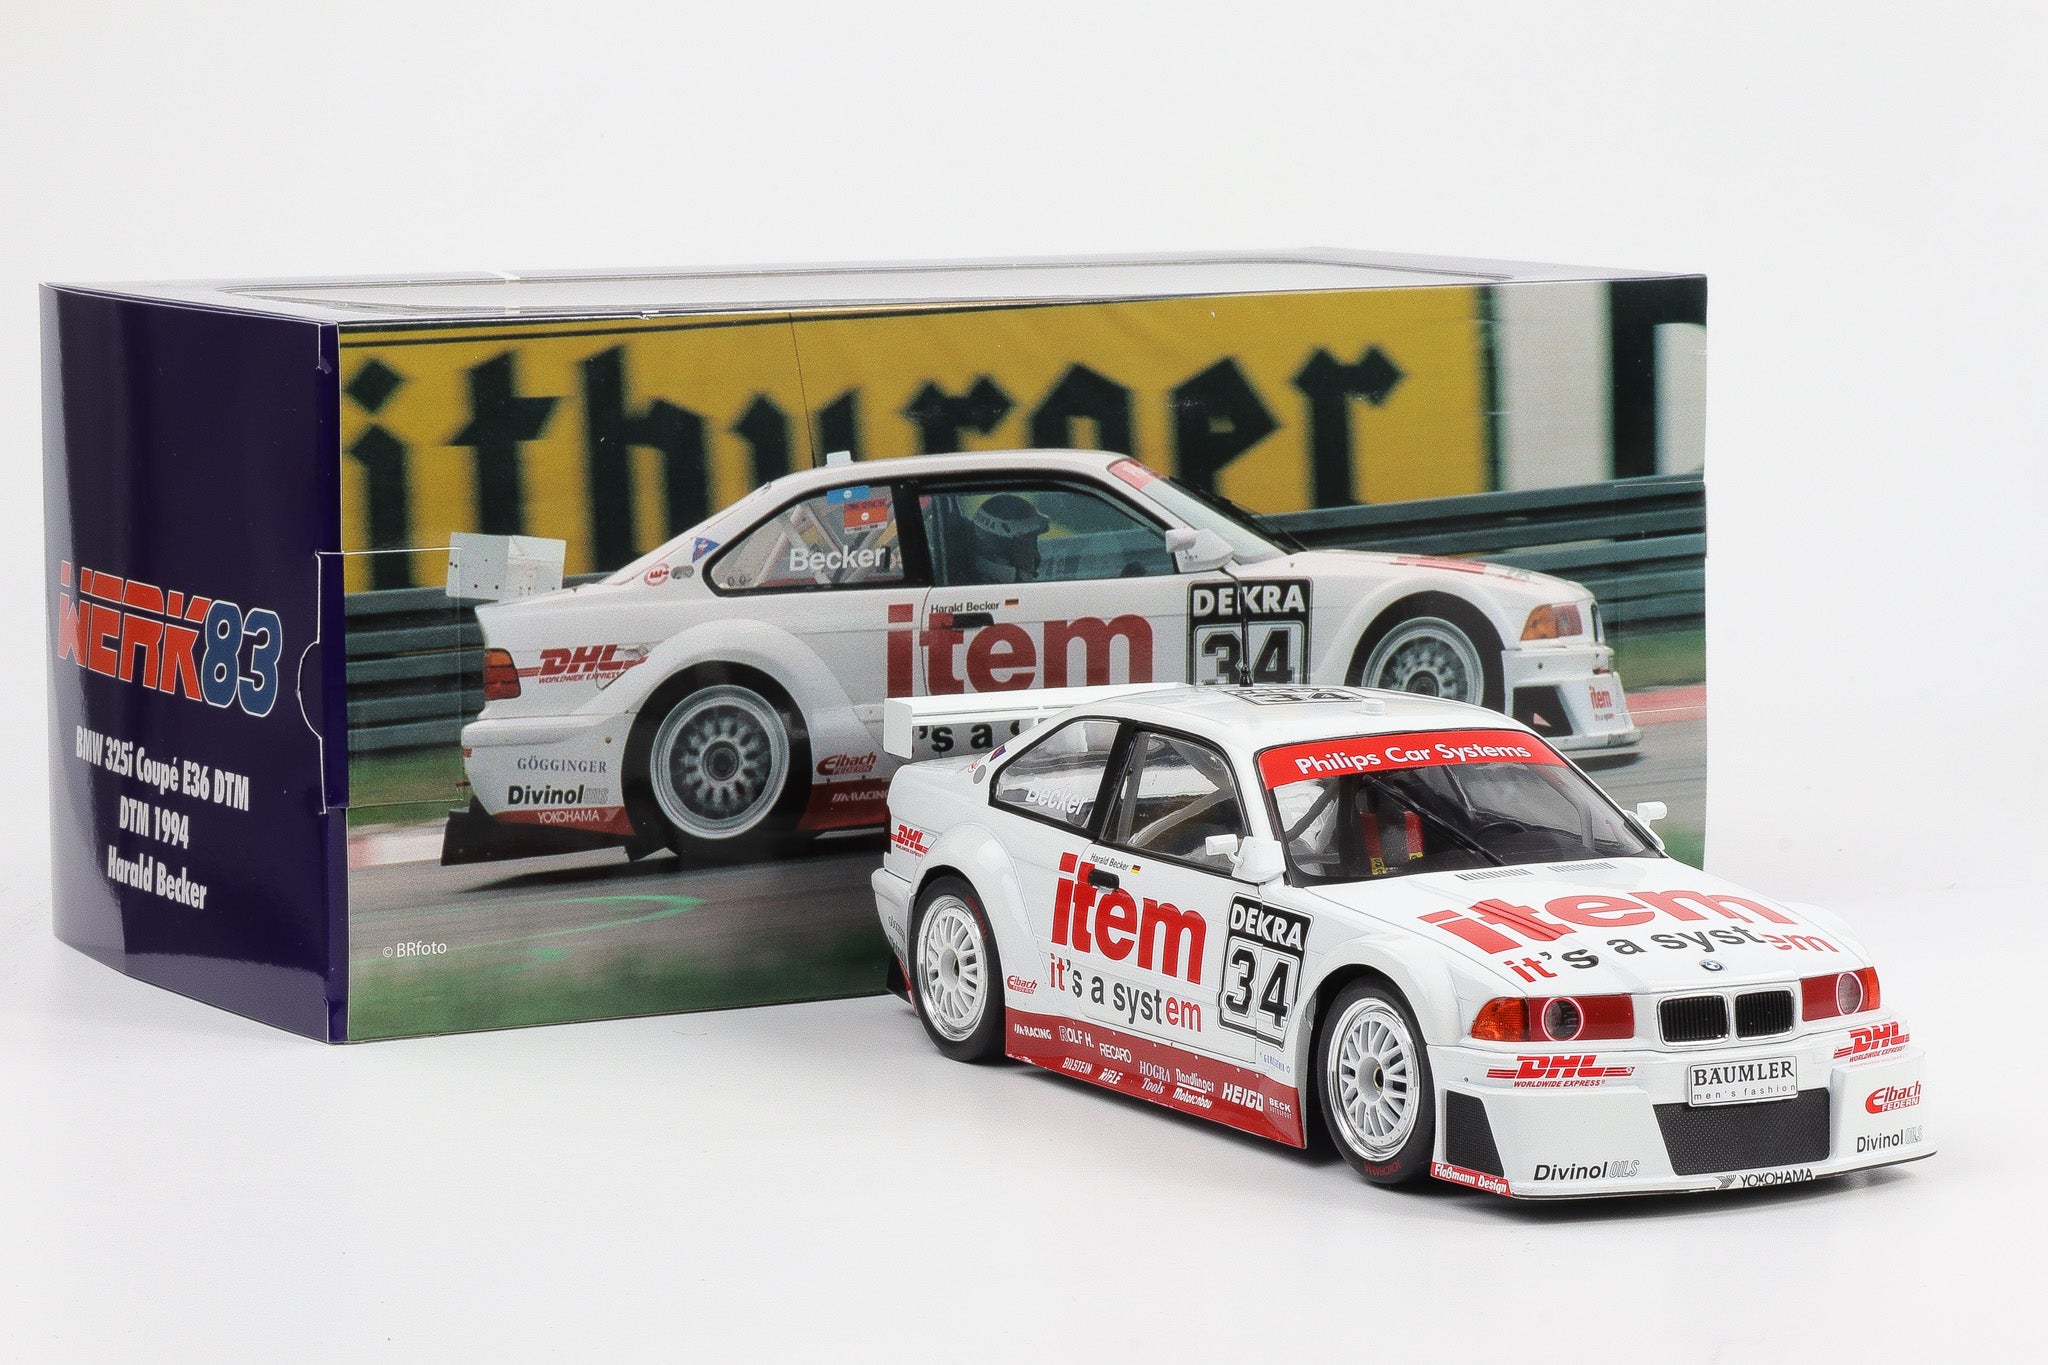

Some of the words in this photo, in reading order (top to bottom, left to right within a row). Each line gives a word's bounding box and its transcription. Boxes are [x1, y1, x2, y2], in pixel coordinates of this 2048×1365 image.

[789, 545, 886, 571] Becker
[930, 603, 963, 613] Harald
[965, 600, 1000, 612] Becker
[1193, 585, 1307, 617] DEKRA
[539, 644, 624, 676] DHL
[887, 603, 1153, 698] item
[1202, 627, 1293, 685] 34
[75, 725, 103, 767] BMW
[105, 735, 134, 779] 325i
[136, 746, 181, 795] Coupé
[183, 764, 210, 801] E36
[213, 772, 250, 812] DTM
[517, 755, 607, 774] GÖGGINGER
[1294, 752, 1381, 775] Philips
[1384, 747, 1431, 764] Car
[1435, 743, 1532, 764] Systems
[507, 784, 585, 805] Divinol
[119, 795, 150, 837] DTM
[153, 802, 190, 849] 1994
[537, 809, 600, 823] YOKOHAMA
[1090, 853, 1109, 865] Harald
[1109, 857, 1130, 872] Becker
[107, 845, 153, 893] Harald
[156, 866, 207, 911] Becker
[1050, 852, 1207, 985] item
[1231, 902, 1304, 951] DEKRA
[1418, 889, 1797, 955] item
[396, 940, 447, 958] BRfoto
[1607, 938, 1646, 955] a
[1651, 925, 1839, 955] system
[1007, 975, 1038, 990] Eibach
[1050, 953, 1083, 998] it's
[1091, 974, 1105, 1005] a
[1113, 984, 1202, 1033] system
[1223, 946, 1292, 1029] 34
[1059, 1025, 1083, 1044] ROLF
[1085, 1034, 1094, 1048] H.
[1850, 1021, 1906, 1054] DHL
[1099, 1043, 1132, 1064] RECARO
[1062, 1057, 1093, 1075] BILSTEIN
[1098, 1068, 1123, 1085] RIFLE
[1139, 1060, 1171, 1083] HOGRA
[1516, 1055, 1606, 1079] DHL
[1693, 1061, 1795, 1086] BÄUMLER
[1141, 1078, 1166, 1095] Tools
[1513, 1080, 1562, 1088] WORLDWIDE
[1694, 1089, 1737, 1100] men's
[1744, 1083, 1797, 1096] fashion
[1269, 1097, 1292, 1113] BECK
[1865, 1081, 1921, 1115] Eibach
[1881, 1097, 1920, 1112] FEDERN
[1857, 1129, 1903, 1153] Divinol
[1434, 1162, 1476, 1186] Floßmann
[1477, 1175, 1508, 1194] Design
[1533, 1161, 1608, 1181] Divinol
[1609, 1160, 1640, 1178] OILS
[1740, 1168, 1814, 1188] YOKOHAMA
